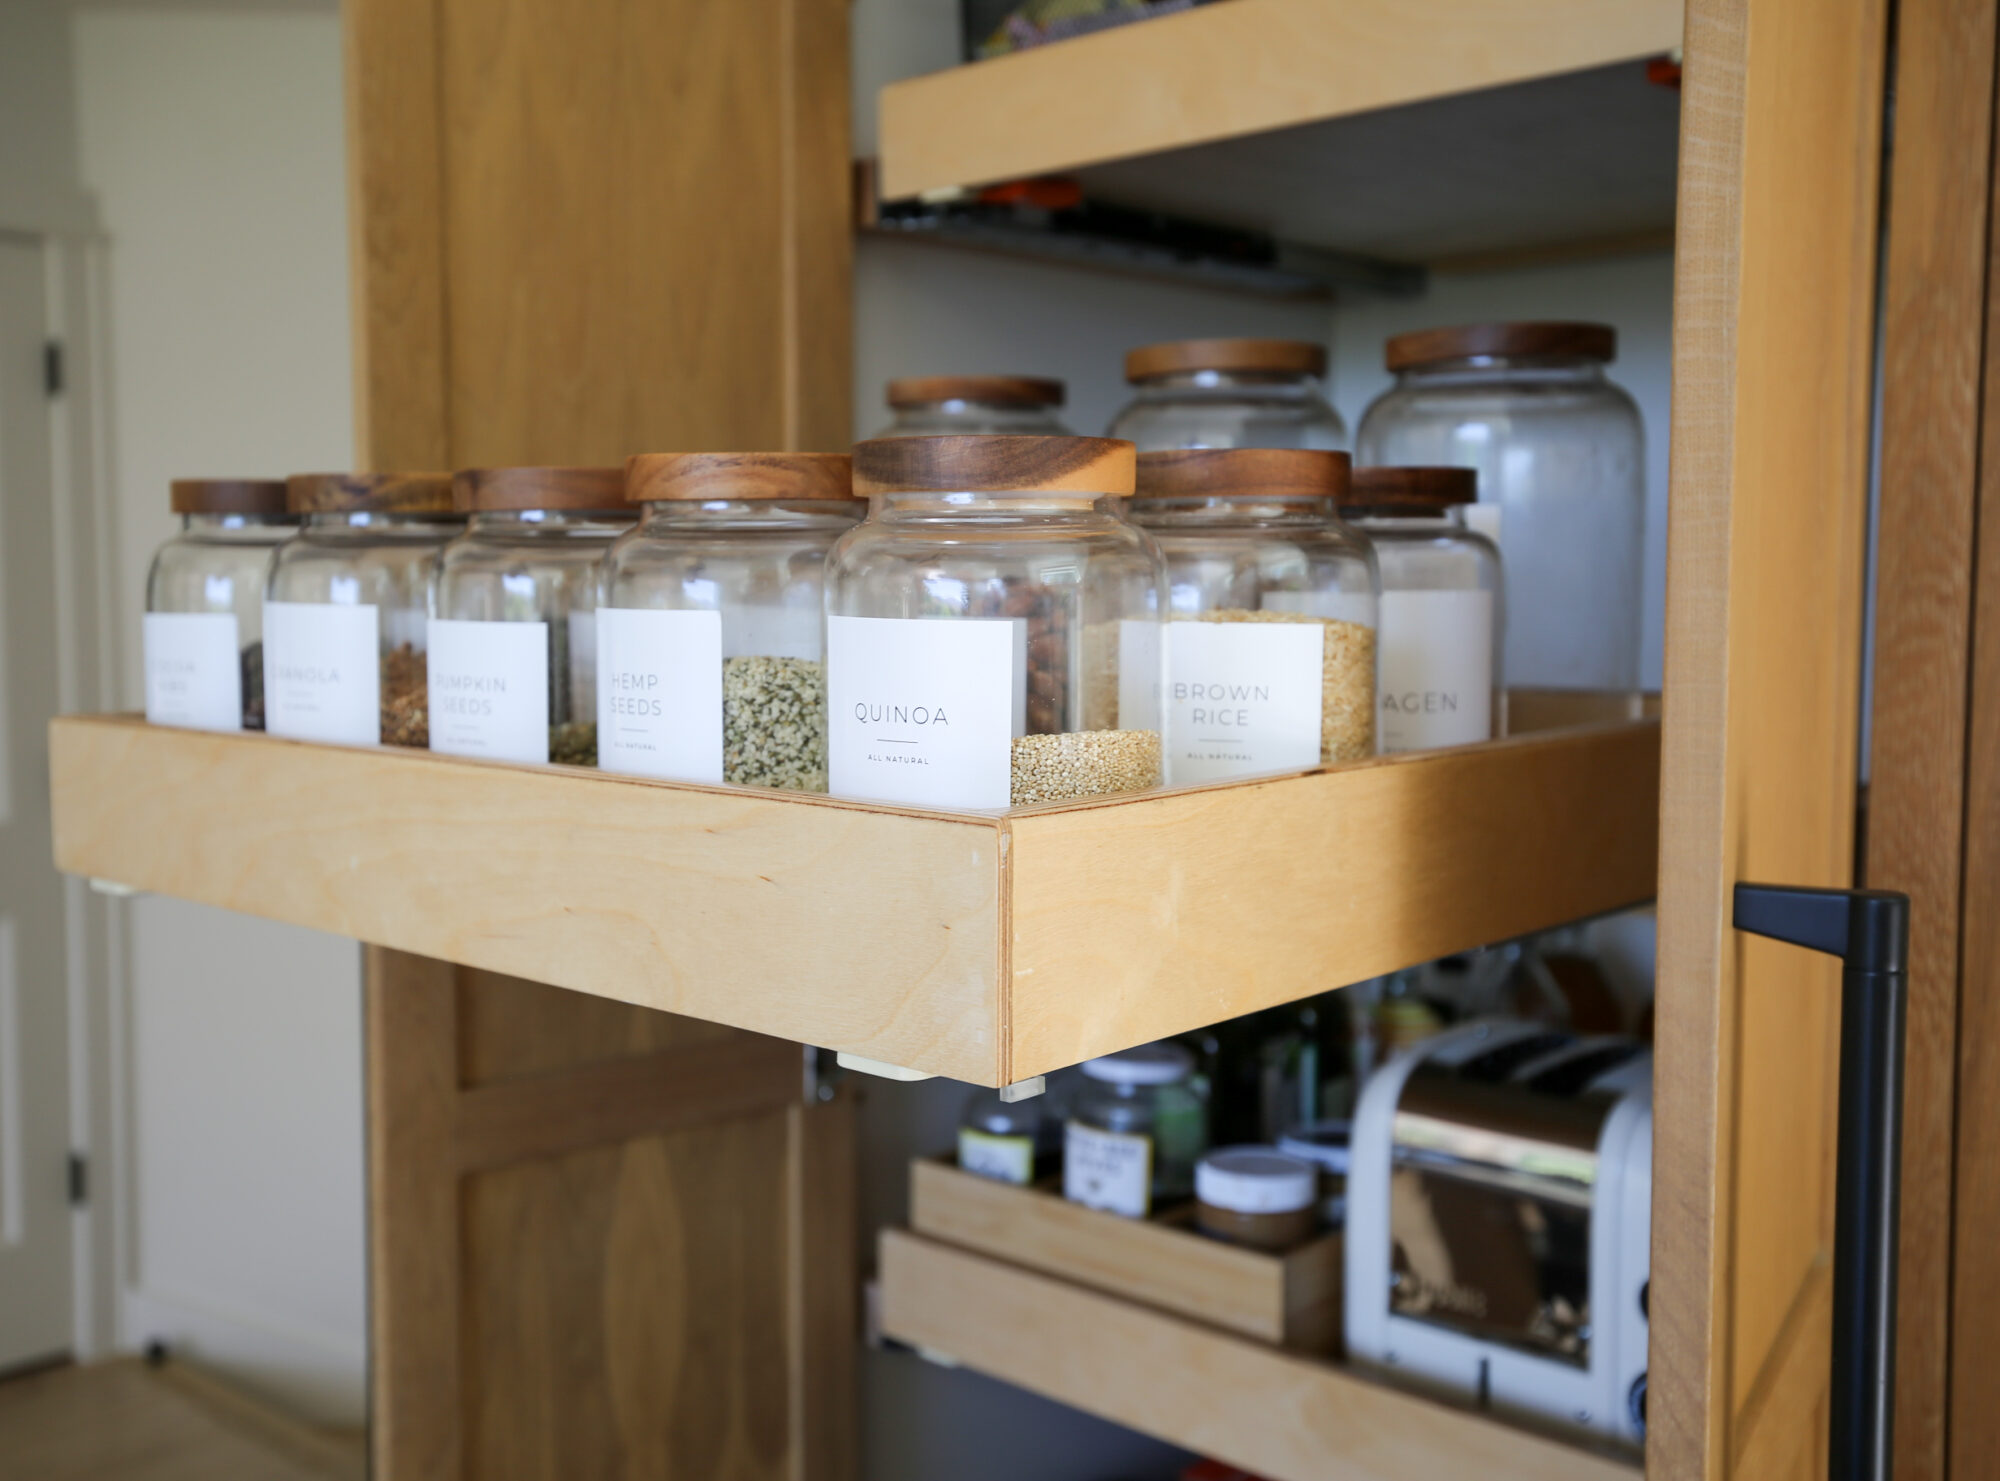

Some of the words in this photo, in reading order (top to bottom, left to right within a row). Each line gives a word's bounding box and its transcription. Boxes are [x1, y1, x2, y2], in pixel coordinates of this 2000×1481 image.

[435, 671, 507, 693] PUMPKIN
[611, 672, 659, 691] HEMP
[1174, 682, 1269, 701] BROWN
[442, 695, 492, 717] SEEDS
[609, 695, 662, 717] SEEDS
[855, 702, 949, 725] QUINOA
[1192, 708, 1249, 727] RICE
[867, 753, 883, 763] ALL
[885, 755, 929, 765] NATURAL
[1187, 752, 1204, 760] ALL
[1207, 753, 1252, 761] NATURAL
